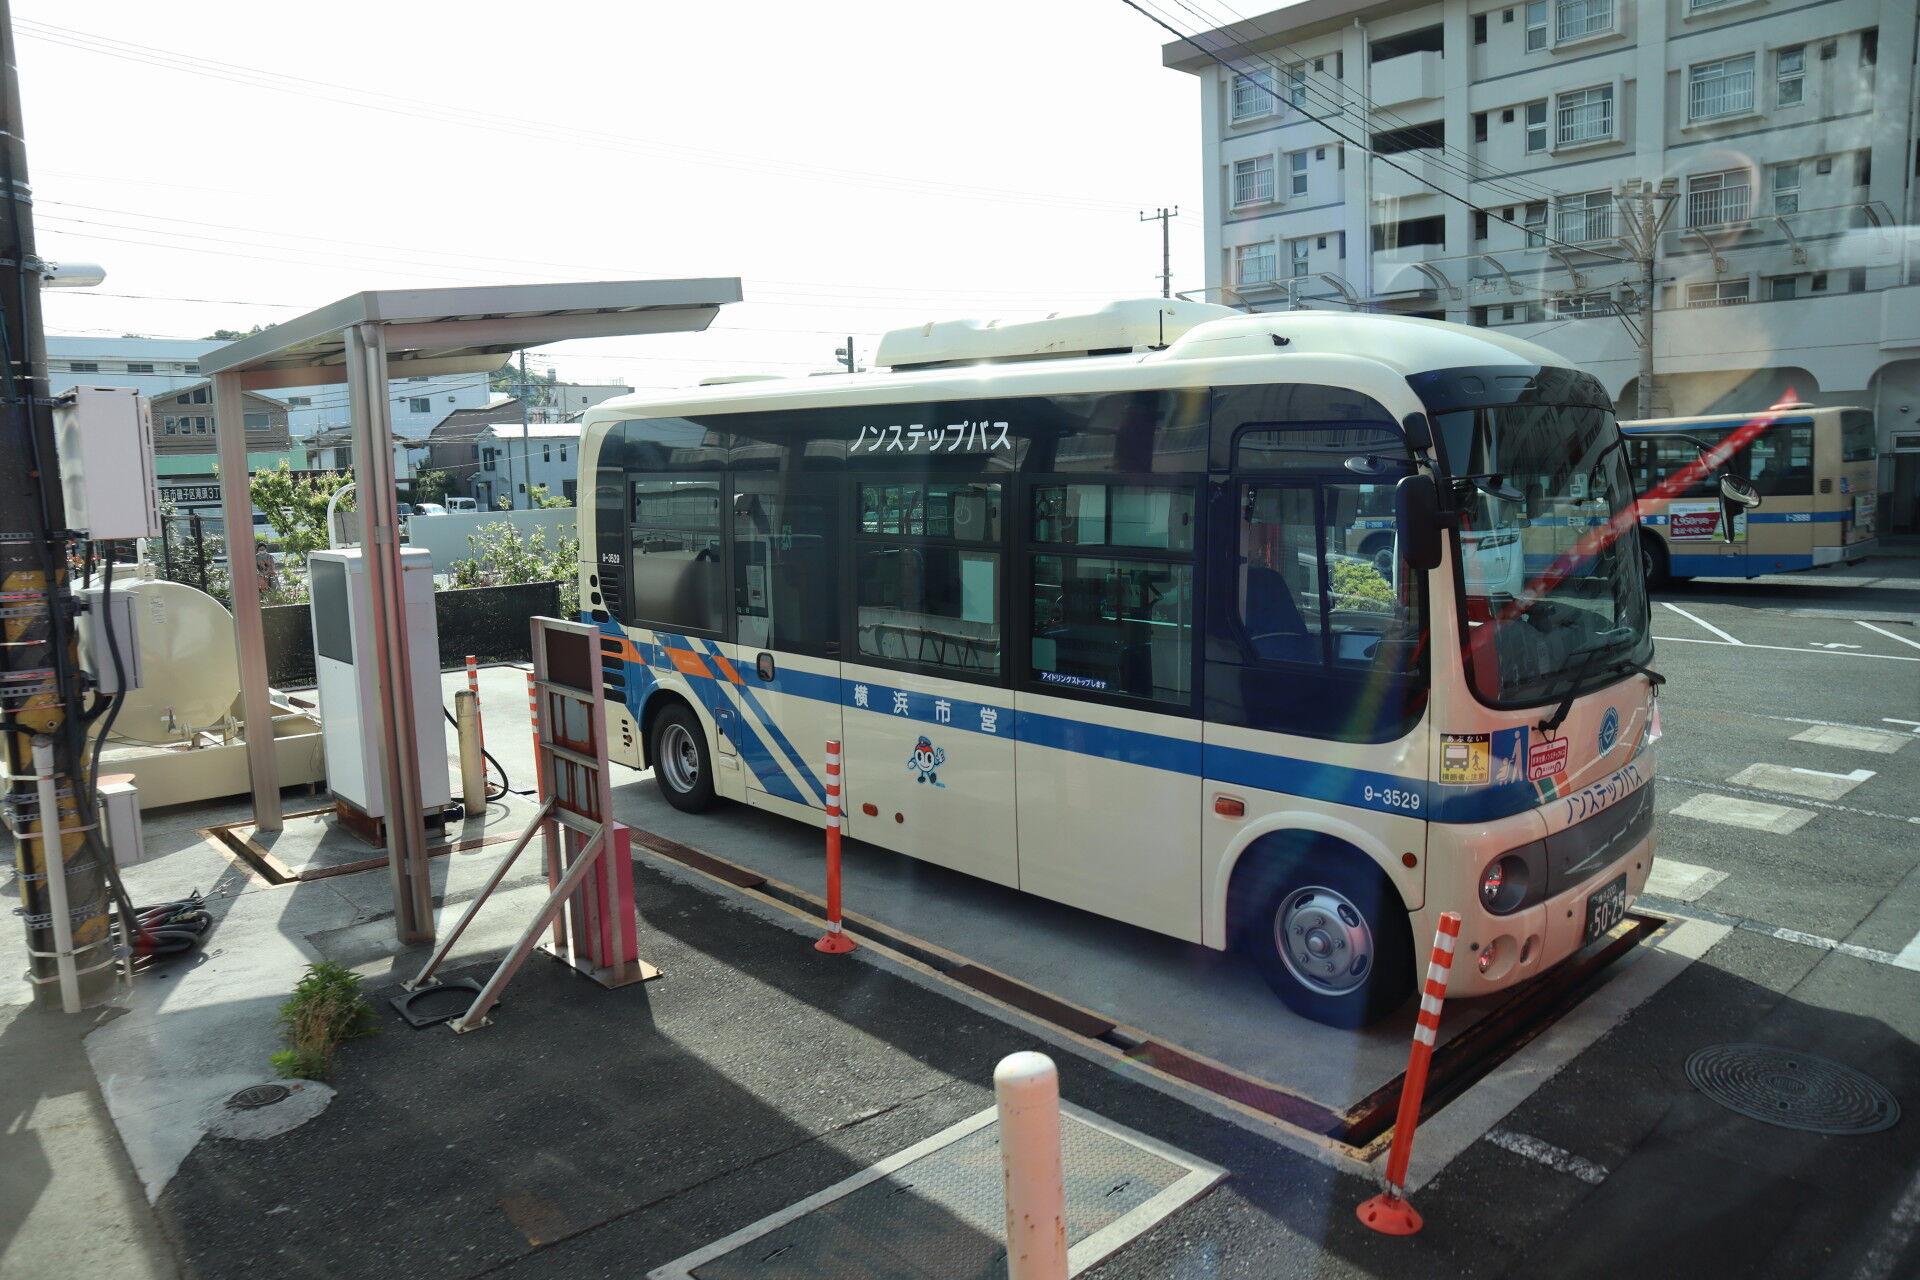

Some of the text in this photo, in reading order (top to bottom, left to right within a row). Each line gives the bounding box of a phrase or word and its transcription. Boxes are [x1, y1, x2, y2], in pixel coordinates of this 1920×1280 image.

[851, 420, 1010, 452] ノンステップバス
[1042, 672, 1107, 689] アイドリングストップします
[854, 684, 998, 733] 横浜市営
[1446, 735, 1483, 743] あぶない
[1364, 785, 1420, 810] 9-3529
[1567, 765, 1643, 824] ノンステップバス
